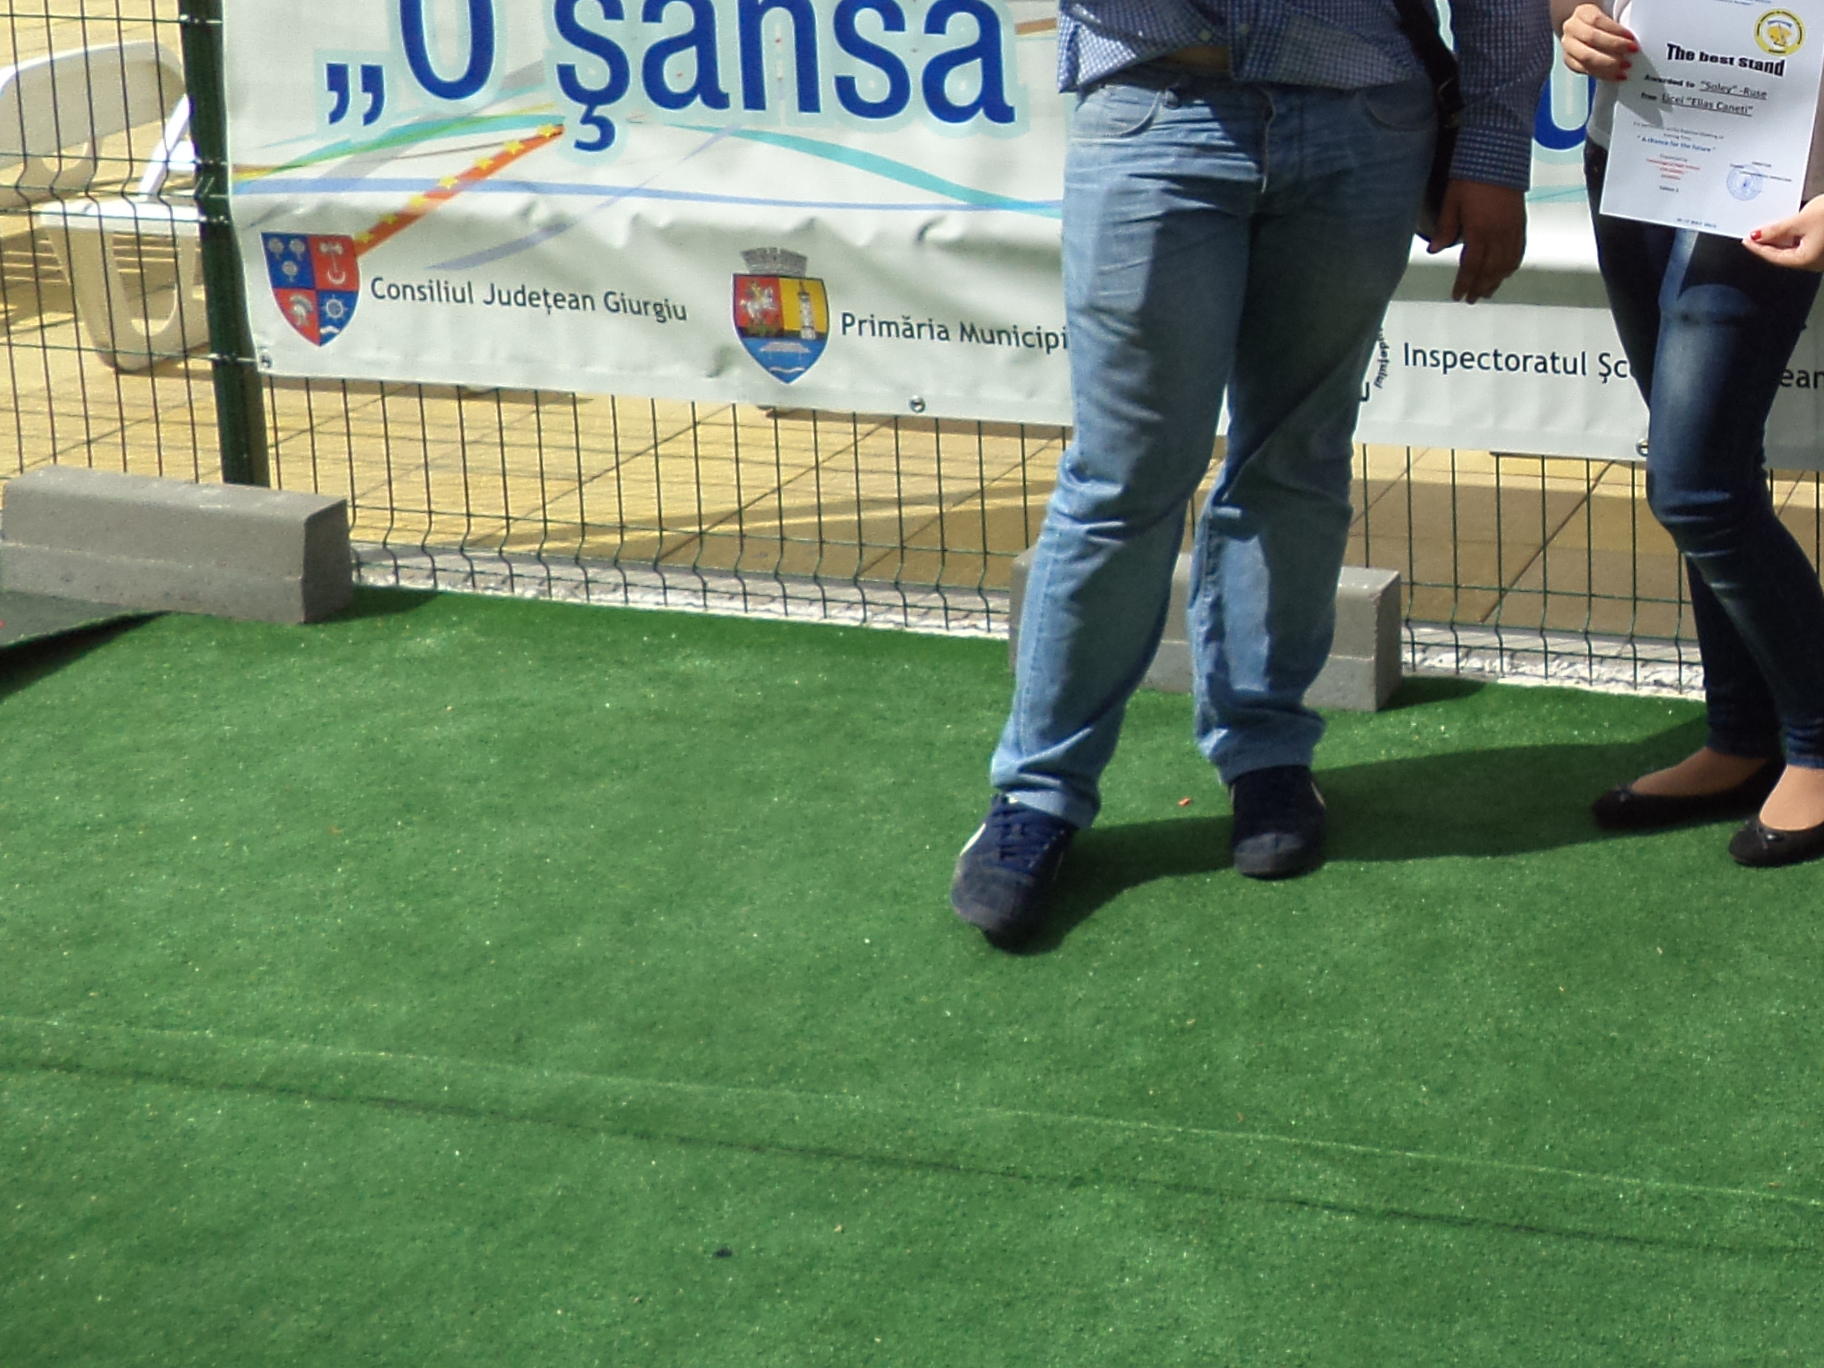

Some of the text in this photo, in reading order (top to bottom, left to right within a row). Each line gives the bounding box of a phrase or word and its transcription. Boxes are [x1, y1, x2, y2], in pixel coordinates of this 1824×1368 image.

[1666, 43, 1695, 62] The
[1699, 52, 1735, 66] best
[370, 277, 474, 305] Consiliul
[603, 290, 688, 324] Giurgiu
[841, 312, 1068, 355] Primăria Municipi
[1404, 342, 1587, 376] Inspectoratul
